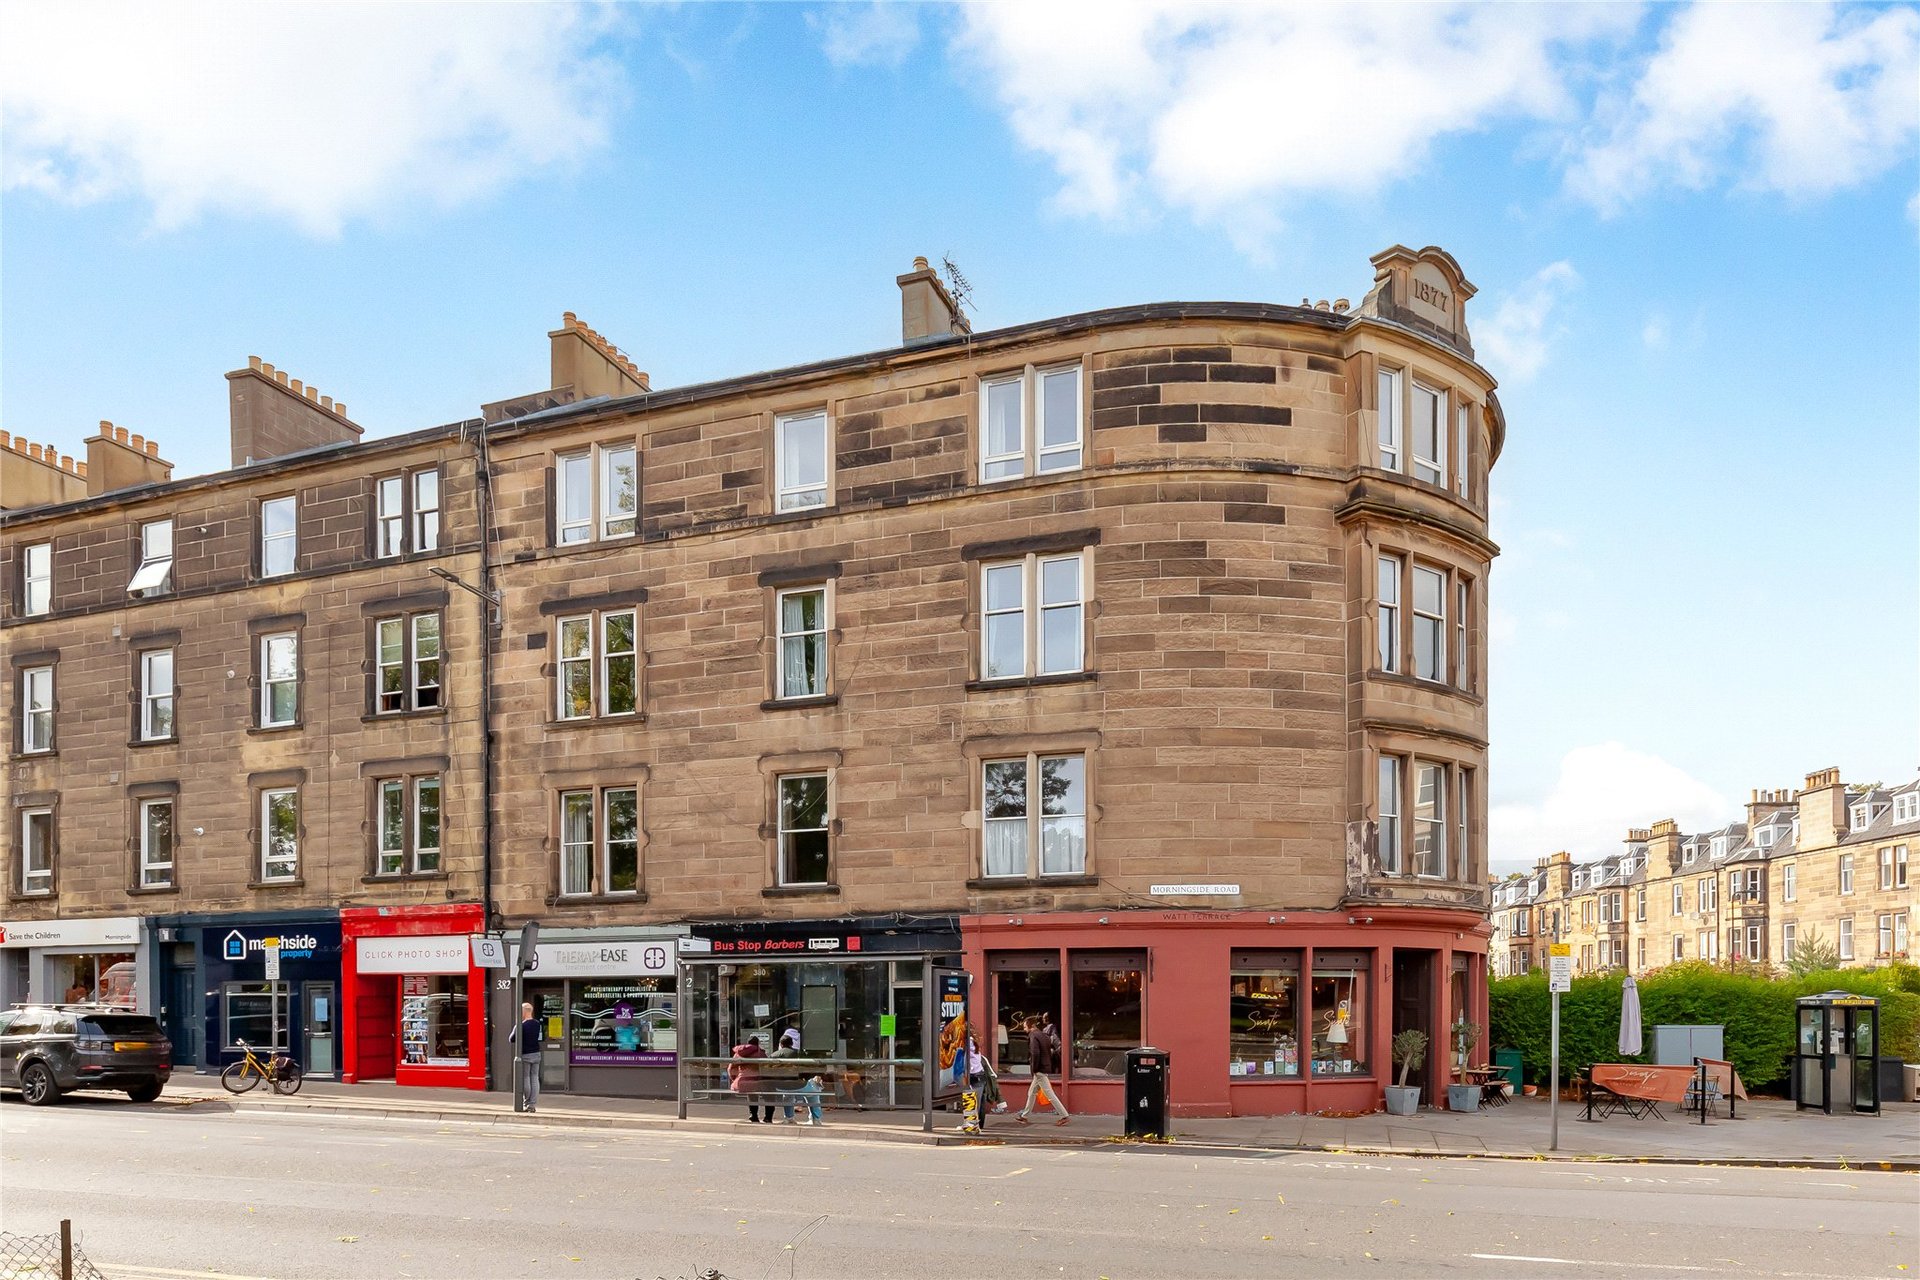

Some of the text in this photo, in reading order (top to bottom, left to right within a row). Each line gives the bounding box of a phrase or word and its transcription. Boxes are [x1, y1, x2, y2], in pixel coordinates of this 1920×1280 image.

[1414, 278, 1449, 312] 1877
[714, 939, 805, 952] Bus Stop Barbers
[280, 949, 313, 959] property
[364, 949, 462, 959] CLICK PHOTO SHOP
[496, 979, 511, 990] 382
